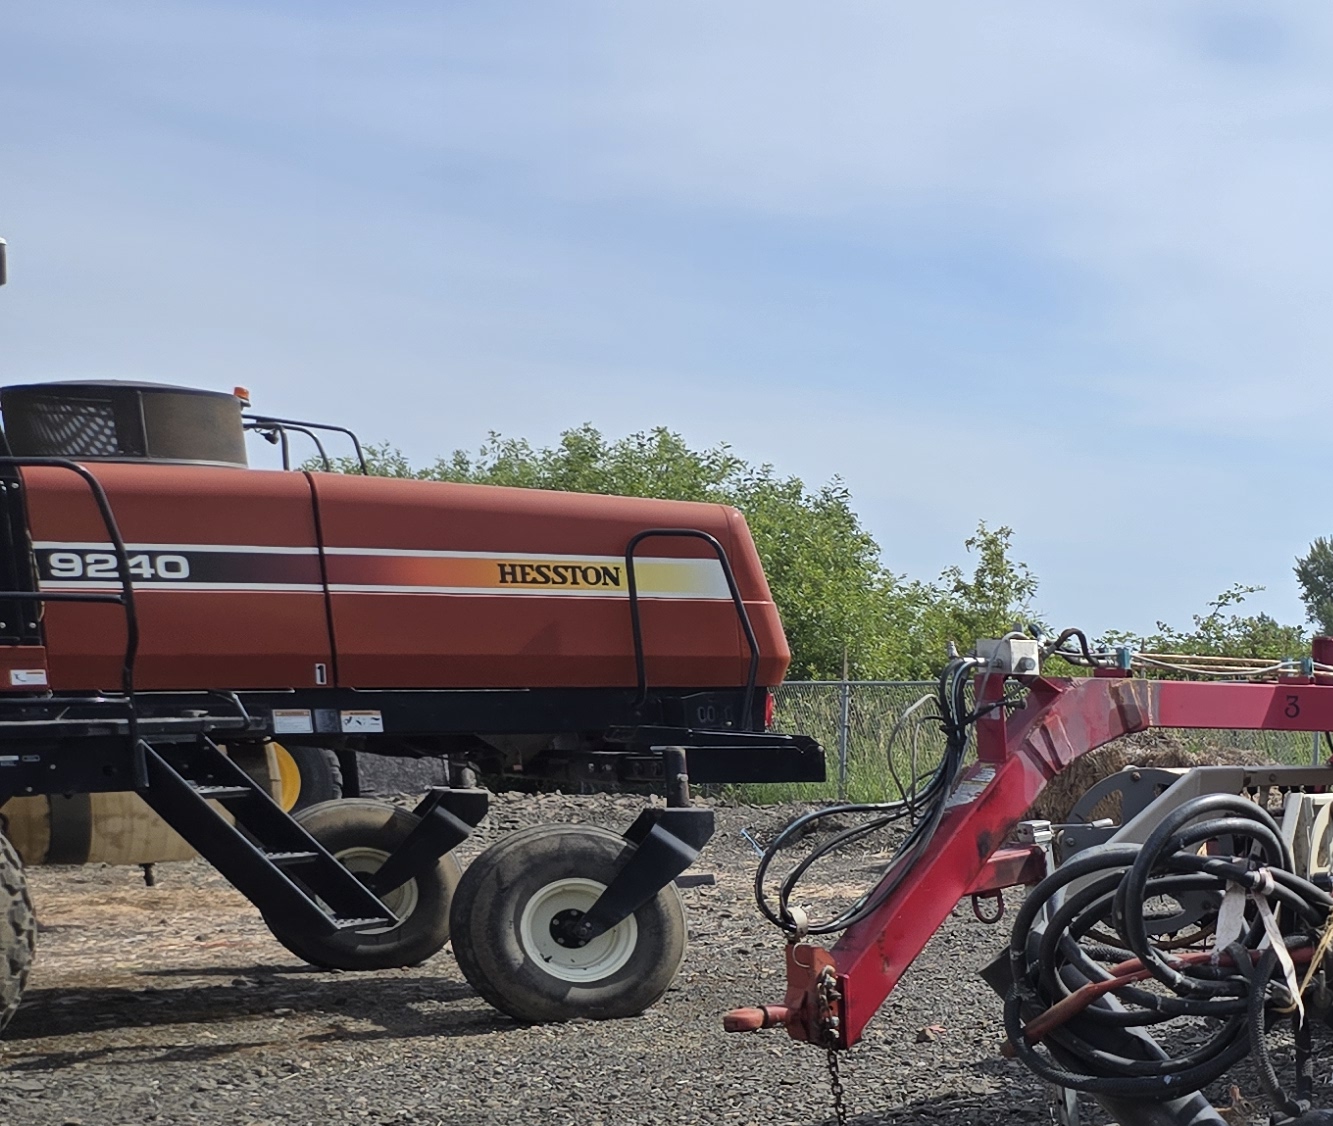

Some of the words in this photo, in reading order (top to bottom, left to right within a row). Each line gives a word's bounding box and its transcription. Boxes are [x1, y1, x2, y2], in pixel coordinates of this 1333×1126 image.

[49, 552, 190, 579] 9240
[497, 563, 620, 587] HESSTON
[1284, 694, 1300, 719] 3
